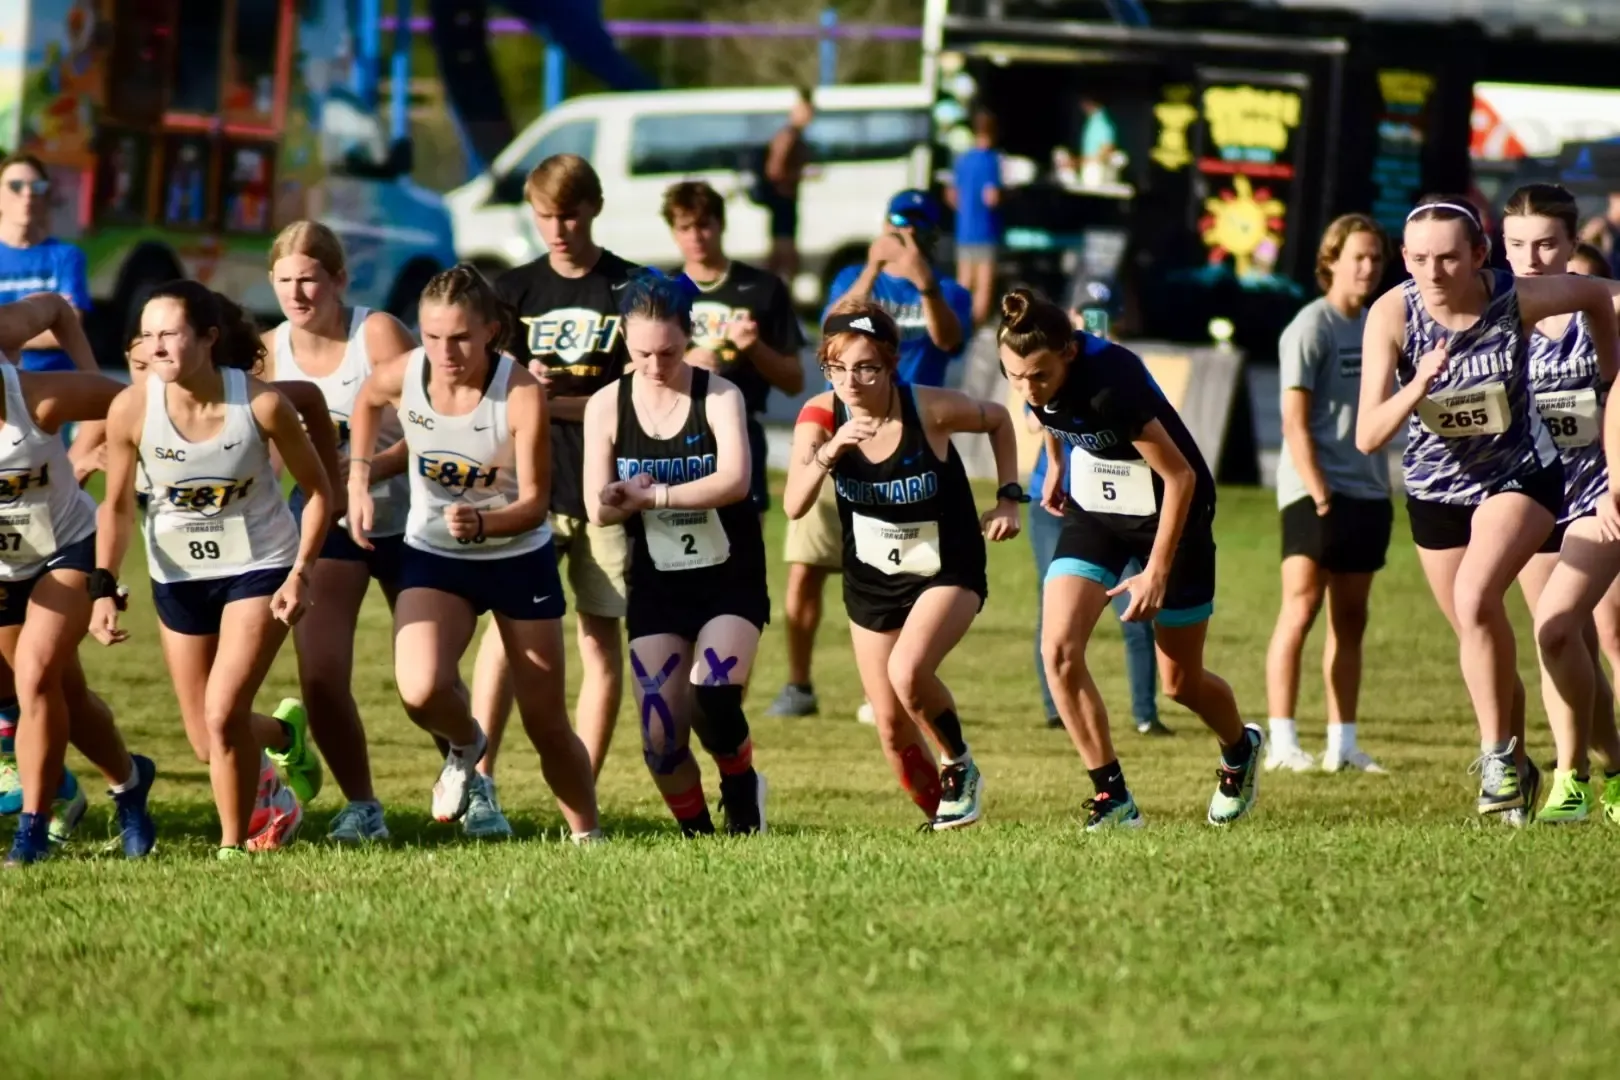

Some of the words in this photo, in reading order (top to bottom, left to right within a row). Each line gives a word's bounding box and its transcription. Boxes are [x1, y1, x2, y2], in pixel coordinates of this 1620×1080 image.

[522, 316, 621, 354] E&H
[1463, 351, 1513, 378] HARRIS
[408, 410, 435, 431] SAC
[1438, 408, 1489, 428] 265
[1547, 416, 1578, 436] 68
[155, 446, 186, 462] SAC
[417, 454, 499, 488] E&H
[166, 477, 254, 508] E&H
[836, 470, 938, 505] BREVARD
[1102, 481, 1117, 500] 5
[188, 541, 221, 560] 89
[681, 534, 698, 555] 2
[888, 548, 902, 566] 4
